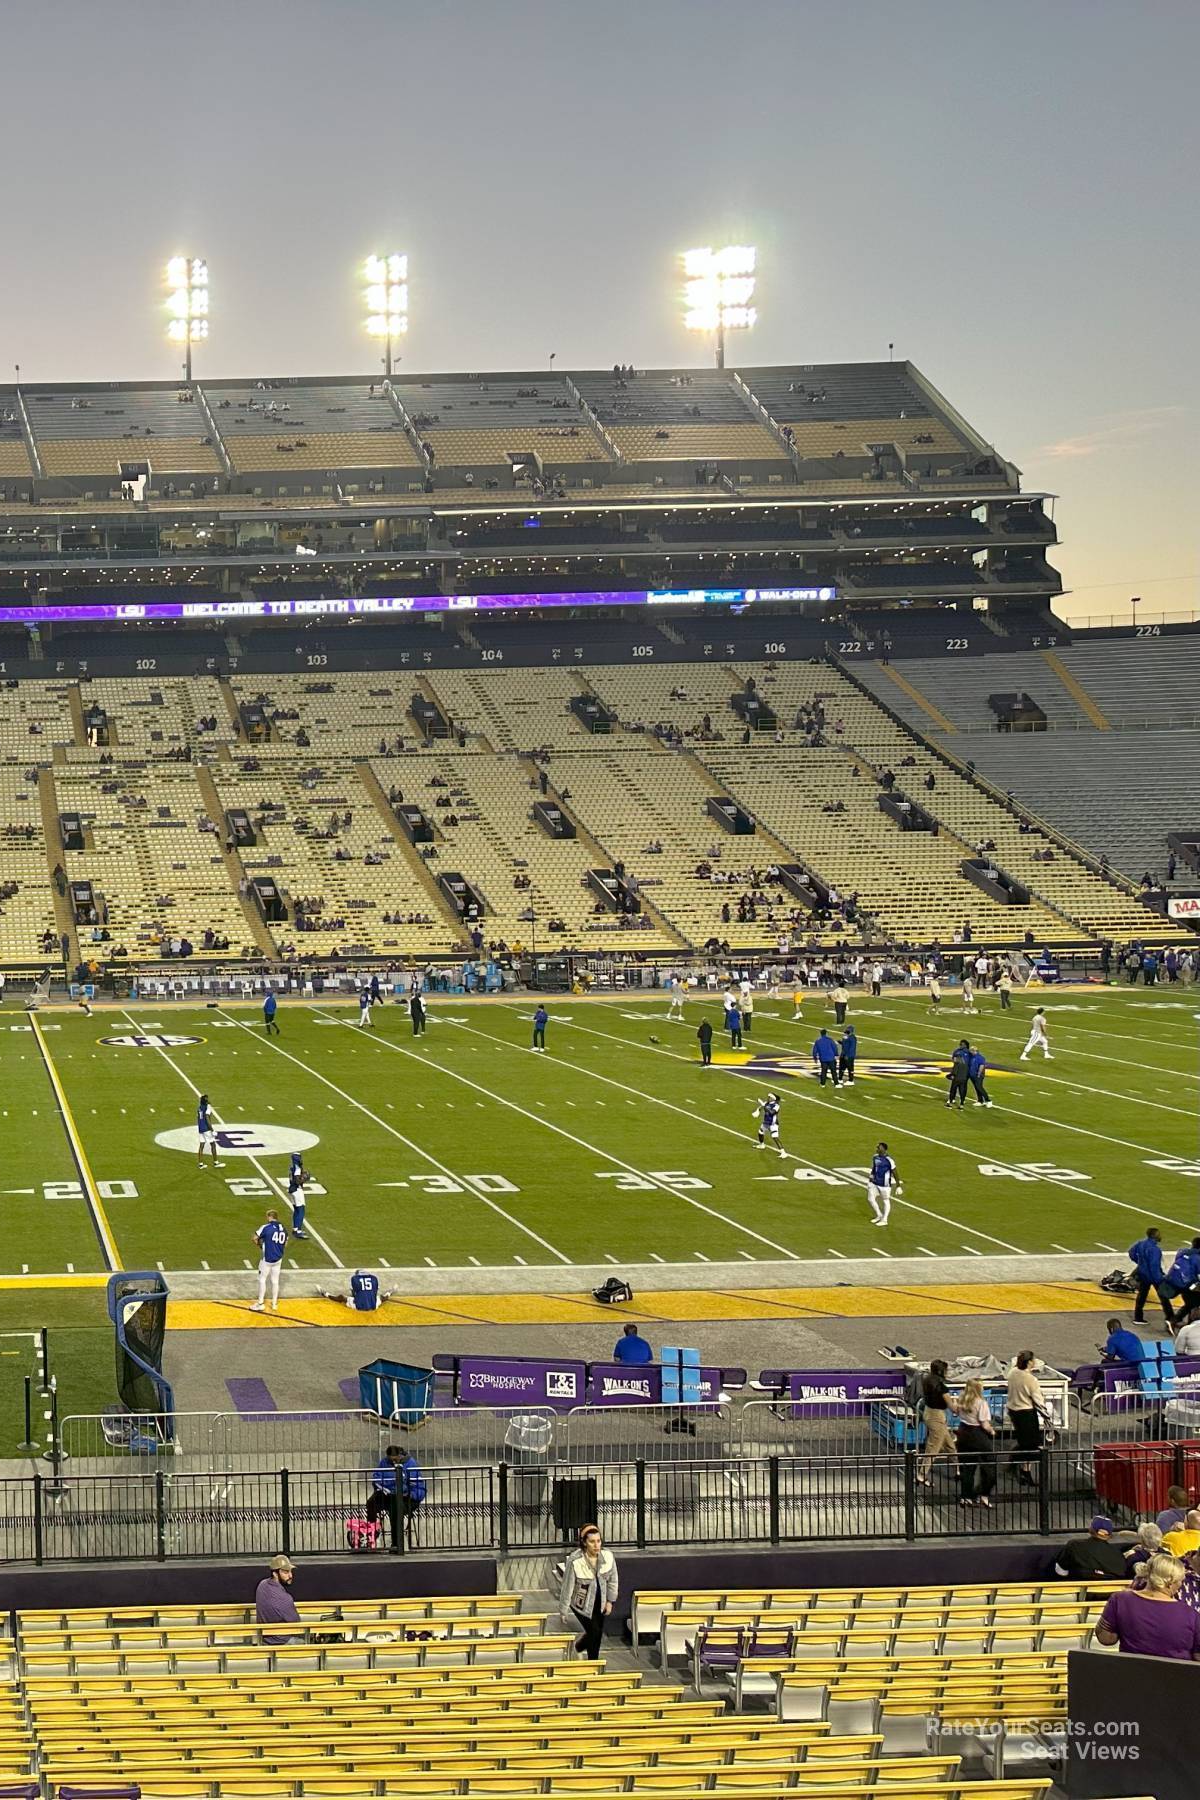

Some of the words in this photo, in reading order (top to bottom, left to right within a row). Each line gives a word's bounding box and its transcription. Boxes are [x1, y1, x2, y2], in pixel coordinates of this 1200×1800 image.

[116, 604, 146, 618] LSU
[182, 601, 264, 617] WELCOME
[270, 600, 291, 614] TO
[298, 599, 349, 614] DEATH
[354, 597, 415, 612] VALLEY
[449, 596, 478, 609] LSU
[1135, 625, 1161, 638] 224
[632, 645, 654, 657] 105
[764, 643, 786, 654] 106
[838, 641, 861, 653] 222
[946, 638, 969, 650] 223
[306, 654, 328, 666] 103
[481, 650, 503, 661] 104
[135, 658, 157, 670] 102
[977, 1163, 1093, 1181] 45
[224, 1177, 328, 1196] 25
[409, 1174, 521, 1192] 30
[594, 1171, 713, 1190] 35
[41, 1180, 139, 1201] 20
[272, 1231, 286, 1245] 40
[359, 1277, 373, 1291] 15
[484, 1373, 537, 1386] BRIDGEWAY
[492, 1382, 526, 1391] HOSPICE
[549, 1375, 575, 1390] H&E
[603, 1377, 650, 1392] WALK-ON'S
[801, 1384, 847, 1399] WALK-ON'S
